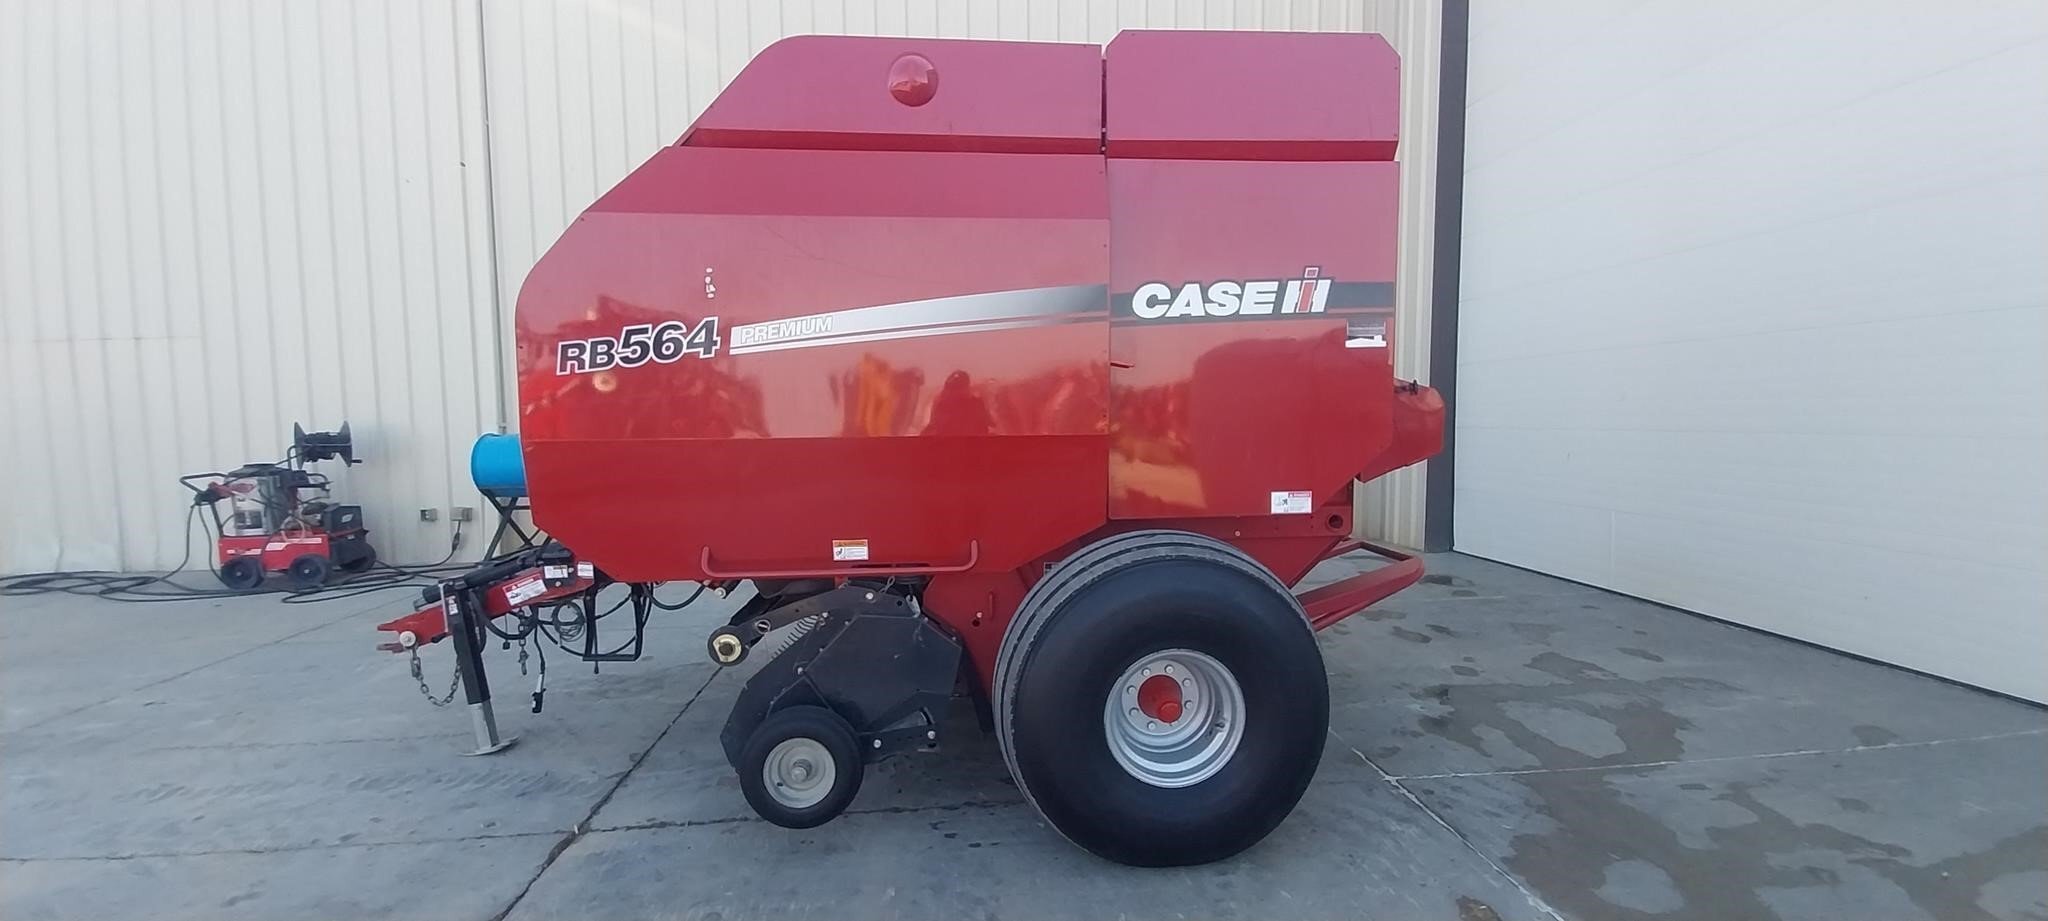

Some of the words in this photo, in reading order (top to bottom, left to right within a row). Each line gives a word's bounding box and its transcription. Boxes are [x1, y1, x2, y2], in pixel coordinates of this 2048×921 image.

[1132, 281, 1278, 319] CASE
[557, 317, 720, 375] RB564
[741, 316, 832, 344] PREMIUM
